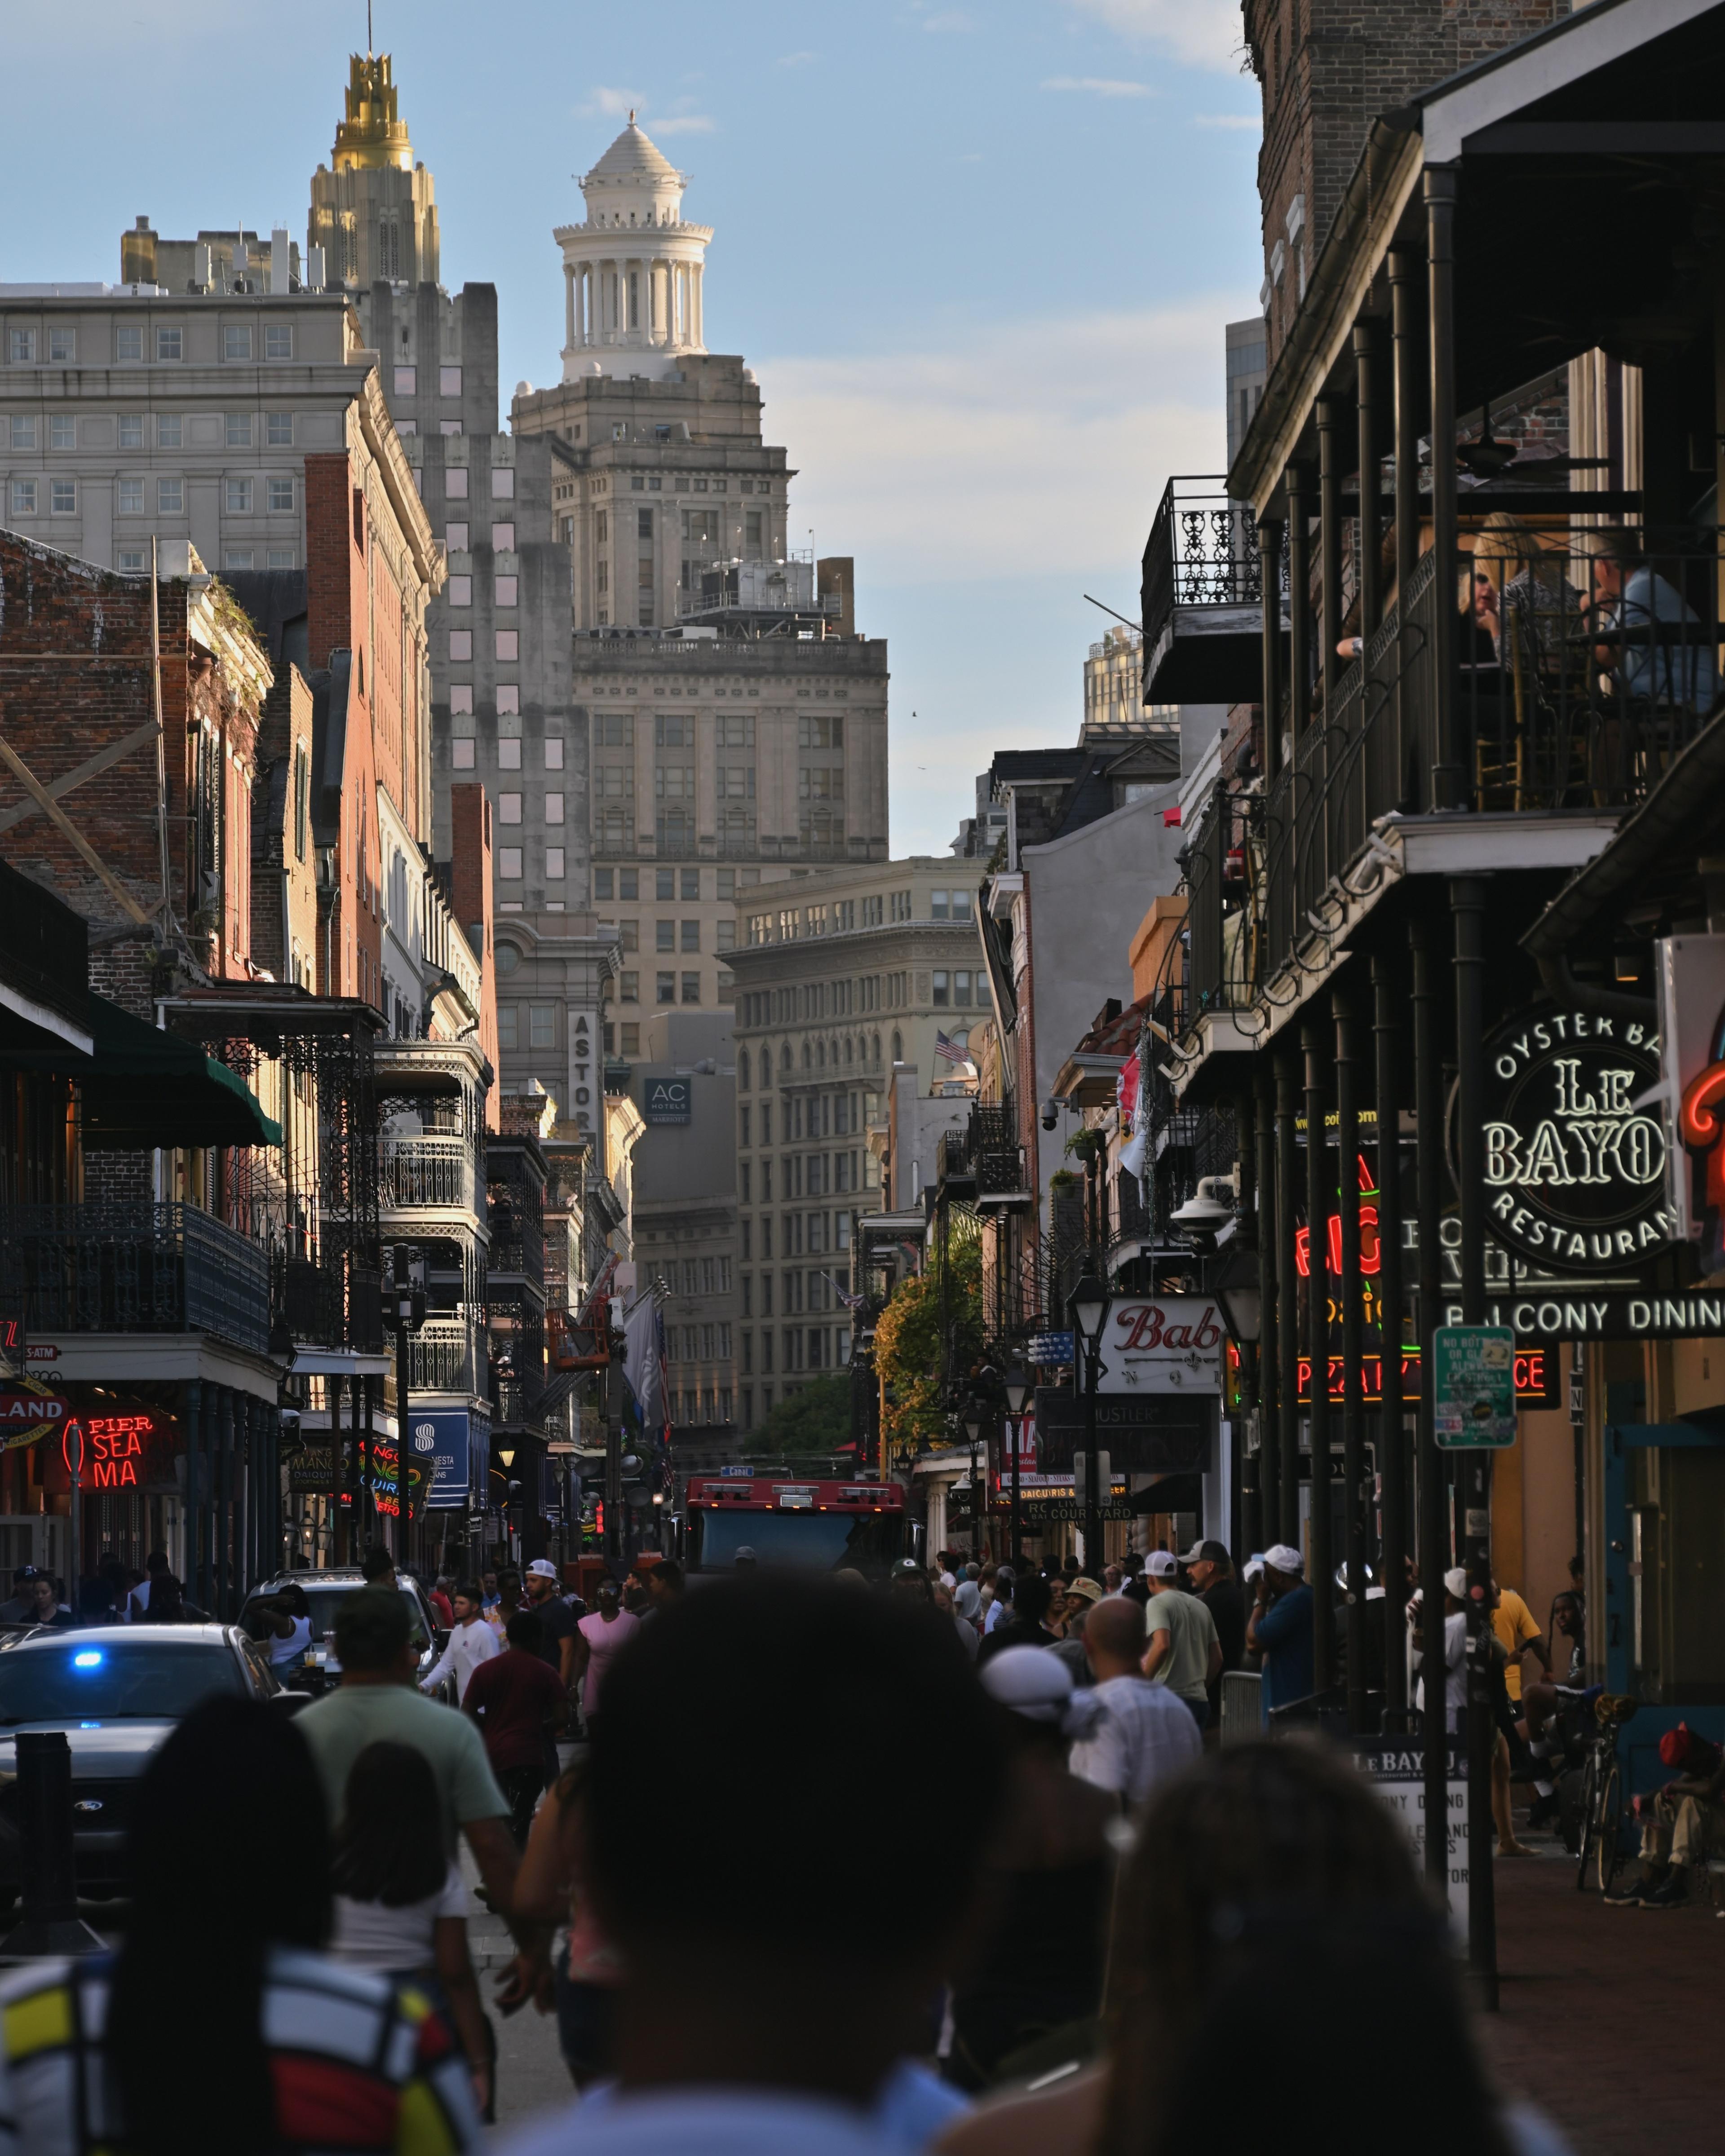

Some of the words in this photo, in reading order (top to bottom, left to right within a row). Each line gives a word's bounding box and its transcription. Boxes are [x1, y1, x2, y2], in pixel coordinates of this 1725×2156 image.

[1496, 1013, 1613, 1079] OYSTER
[1627, 1022, 1661, 1057] BA
[575, 1016, 589, 1129] ASTOR
[652, 1084, 685, 1101] AC
[1553, 1059, 1635, 1117] LE
[1483, 1117, 1665, 1185] BAYO
[1492, 1191, 1678, 1258] RESTAURAN
[1447, 1302, 1607, 1332] BCONY
[1629, 1300, 1725, 1329] DININ
[1095, 1407, 1154, 1423] USTLER
[88, 1417, 153, 1434] PIER
[730, 1467, 748, 1476] Canal
[1058, 1500, 1075, 1508] LIV
[1051, 1508, 1131, 1520] COURYARD
[1382, 1752, 1455, 1771] BAYU
